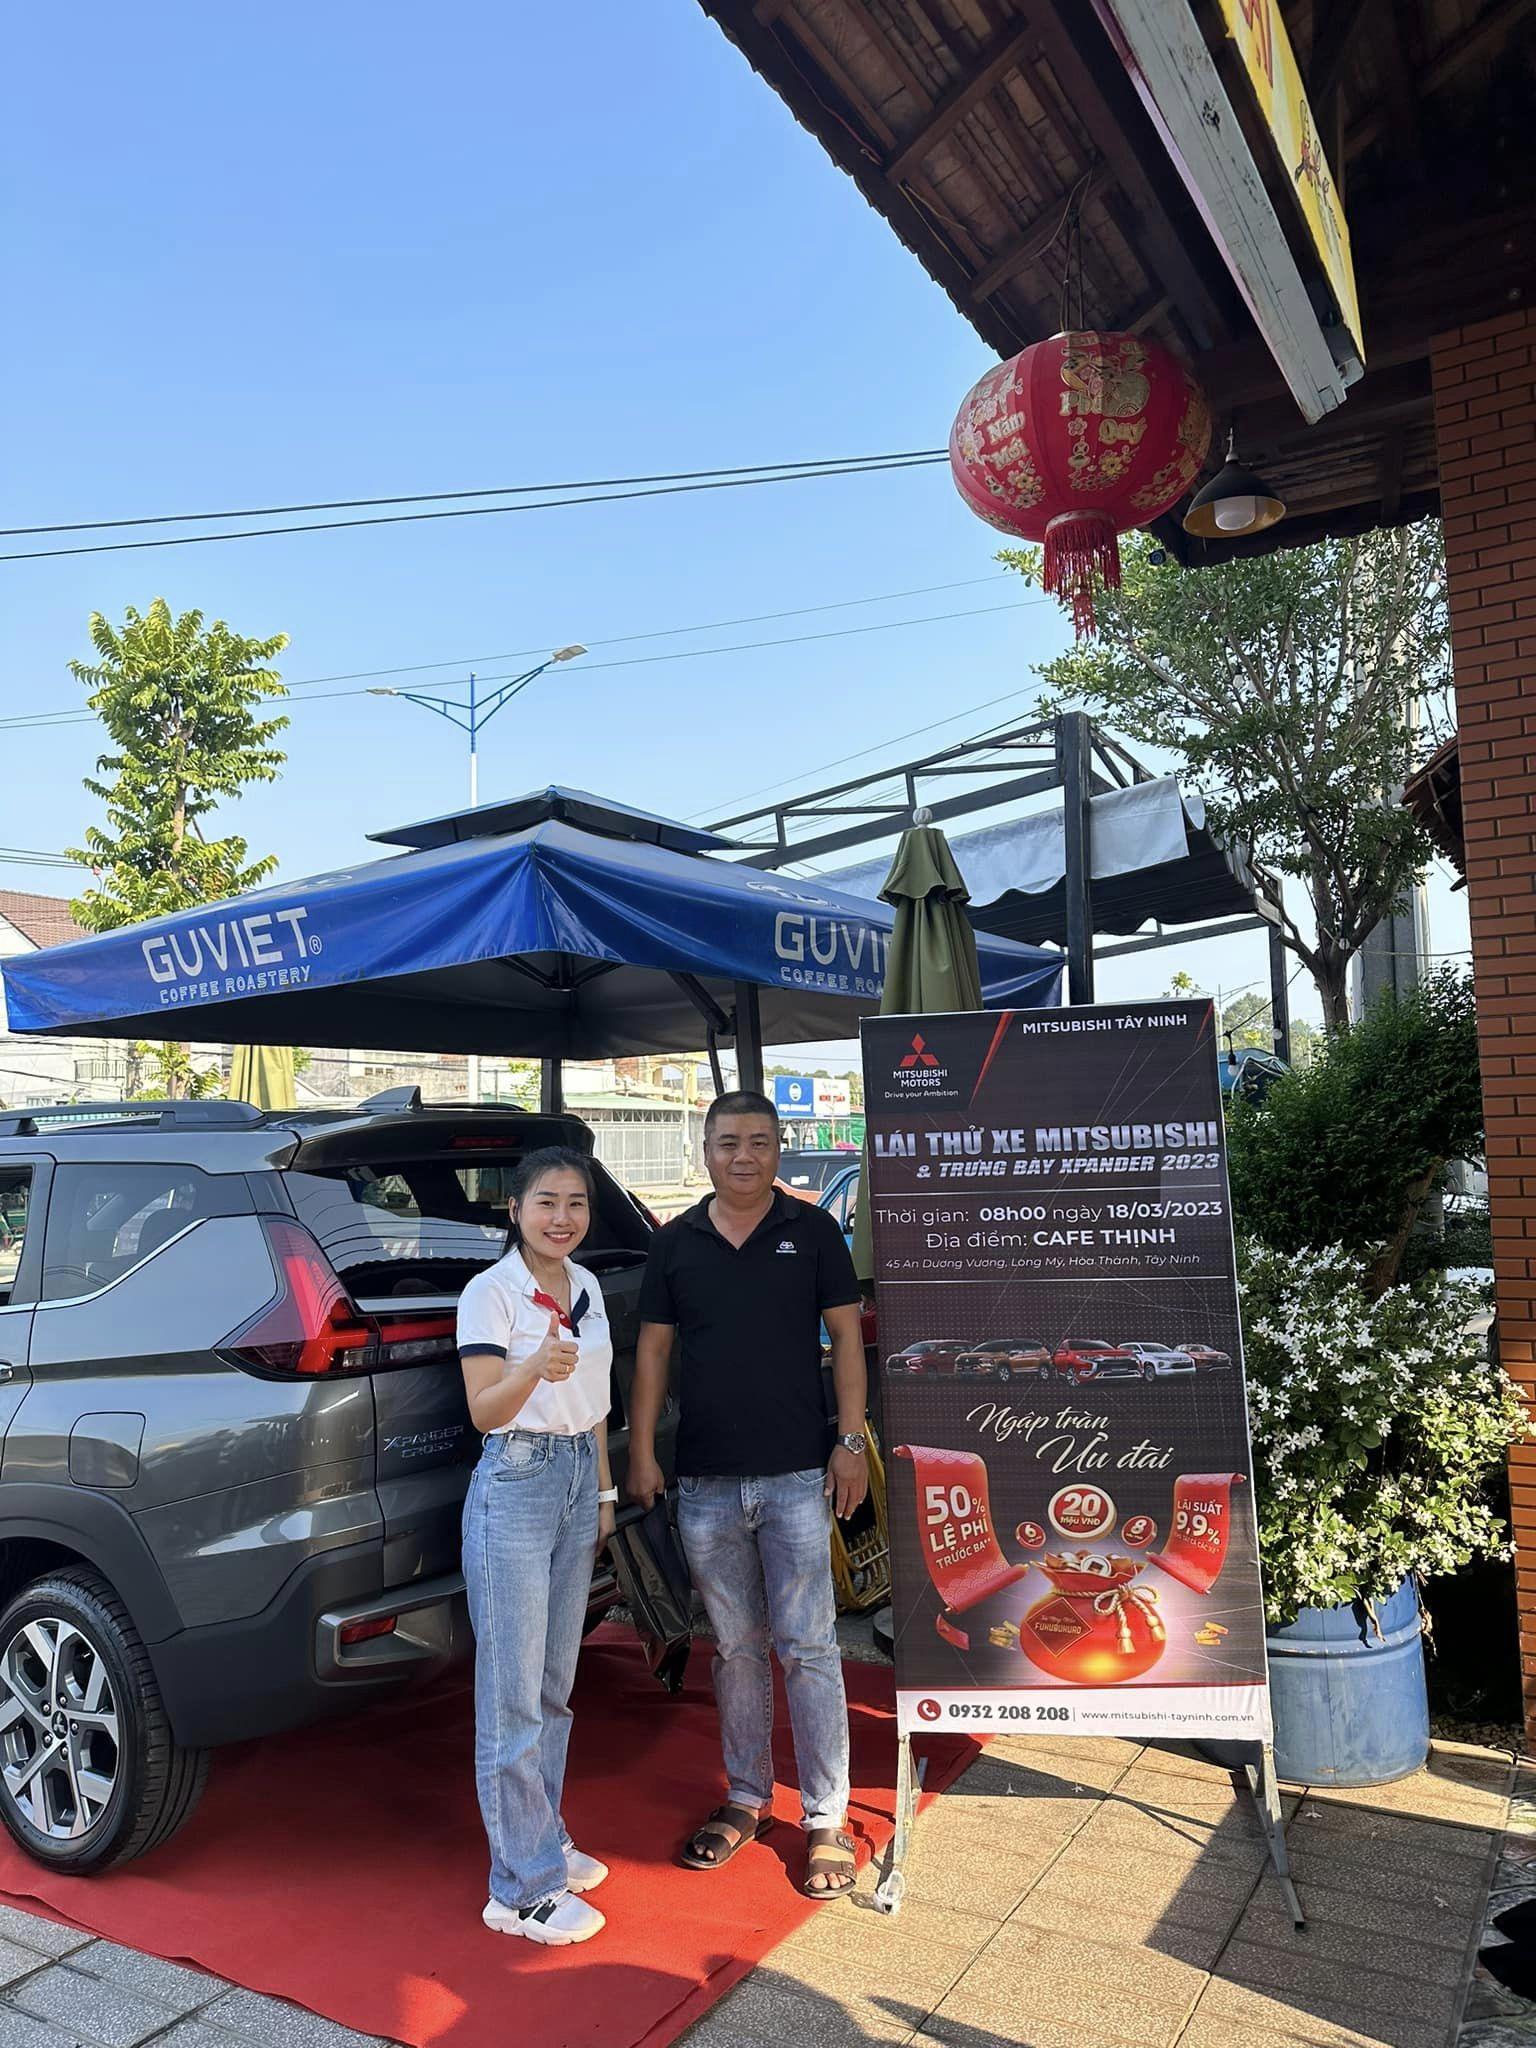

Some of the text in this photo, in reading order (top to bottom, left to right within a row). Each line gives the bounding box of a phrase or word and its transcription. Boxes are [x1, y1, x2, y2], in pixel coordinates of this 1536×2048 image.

[160, 965, 311, 1004] COFFEE ROASTERY
[781, 966, 849, 990] COFFEE
[1023, 1014, 1187, 1034] MITSUBISHI TÂY NINH
[893, 1069, 948, 1079] MITSUBISHI
[901, 1078, 941, 1088] MOTORS
[906, 1091, 922, 1099] your
[874, 1121, 1219, 1158] LÁI THỬ XE MITSUBISHI
[916, 1152, 1220, 1178] & TRƯNG BÀY XPANDER 2023
[875, 1200, 1223, 1226] Thời gian: 08h00 ngày 18/03/2023
[925, 1228, 1176, 1251] Địa điểm: CAFE THỊNH
[885, 1259, 901, 1269] 45
[902, 1258, 920, 1269] An
[1010, 1257, 1042, 1269] Long
[1144, 1255, 1167, 1266] Tây
[1169, 1254, 1201, 1265] Ninh
[966, 1402, 1110, 1442] Ngập tràn
[1035, 1432, 1113, 1474] Ưu
[925, 1485, 986, 1526] 50%
[1062, 1492, 1101, 1517] 20
[1193, 1499, 1223, 1515] SUẤT
[929, 1513, 989, 1552] LỆ PHÍ
[1025, 1524, 1037, 1538] 6
[1130, 1519, 1148, 1534] 8
[1177, 1511, 1221, 1545] 9,9%
[948, 1703, 1255, 1723] 0932 208 208 www.mitsubishi-tayninh.com.vn
